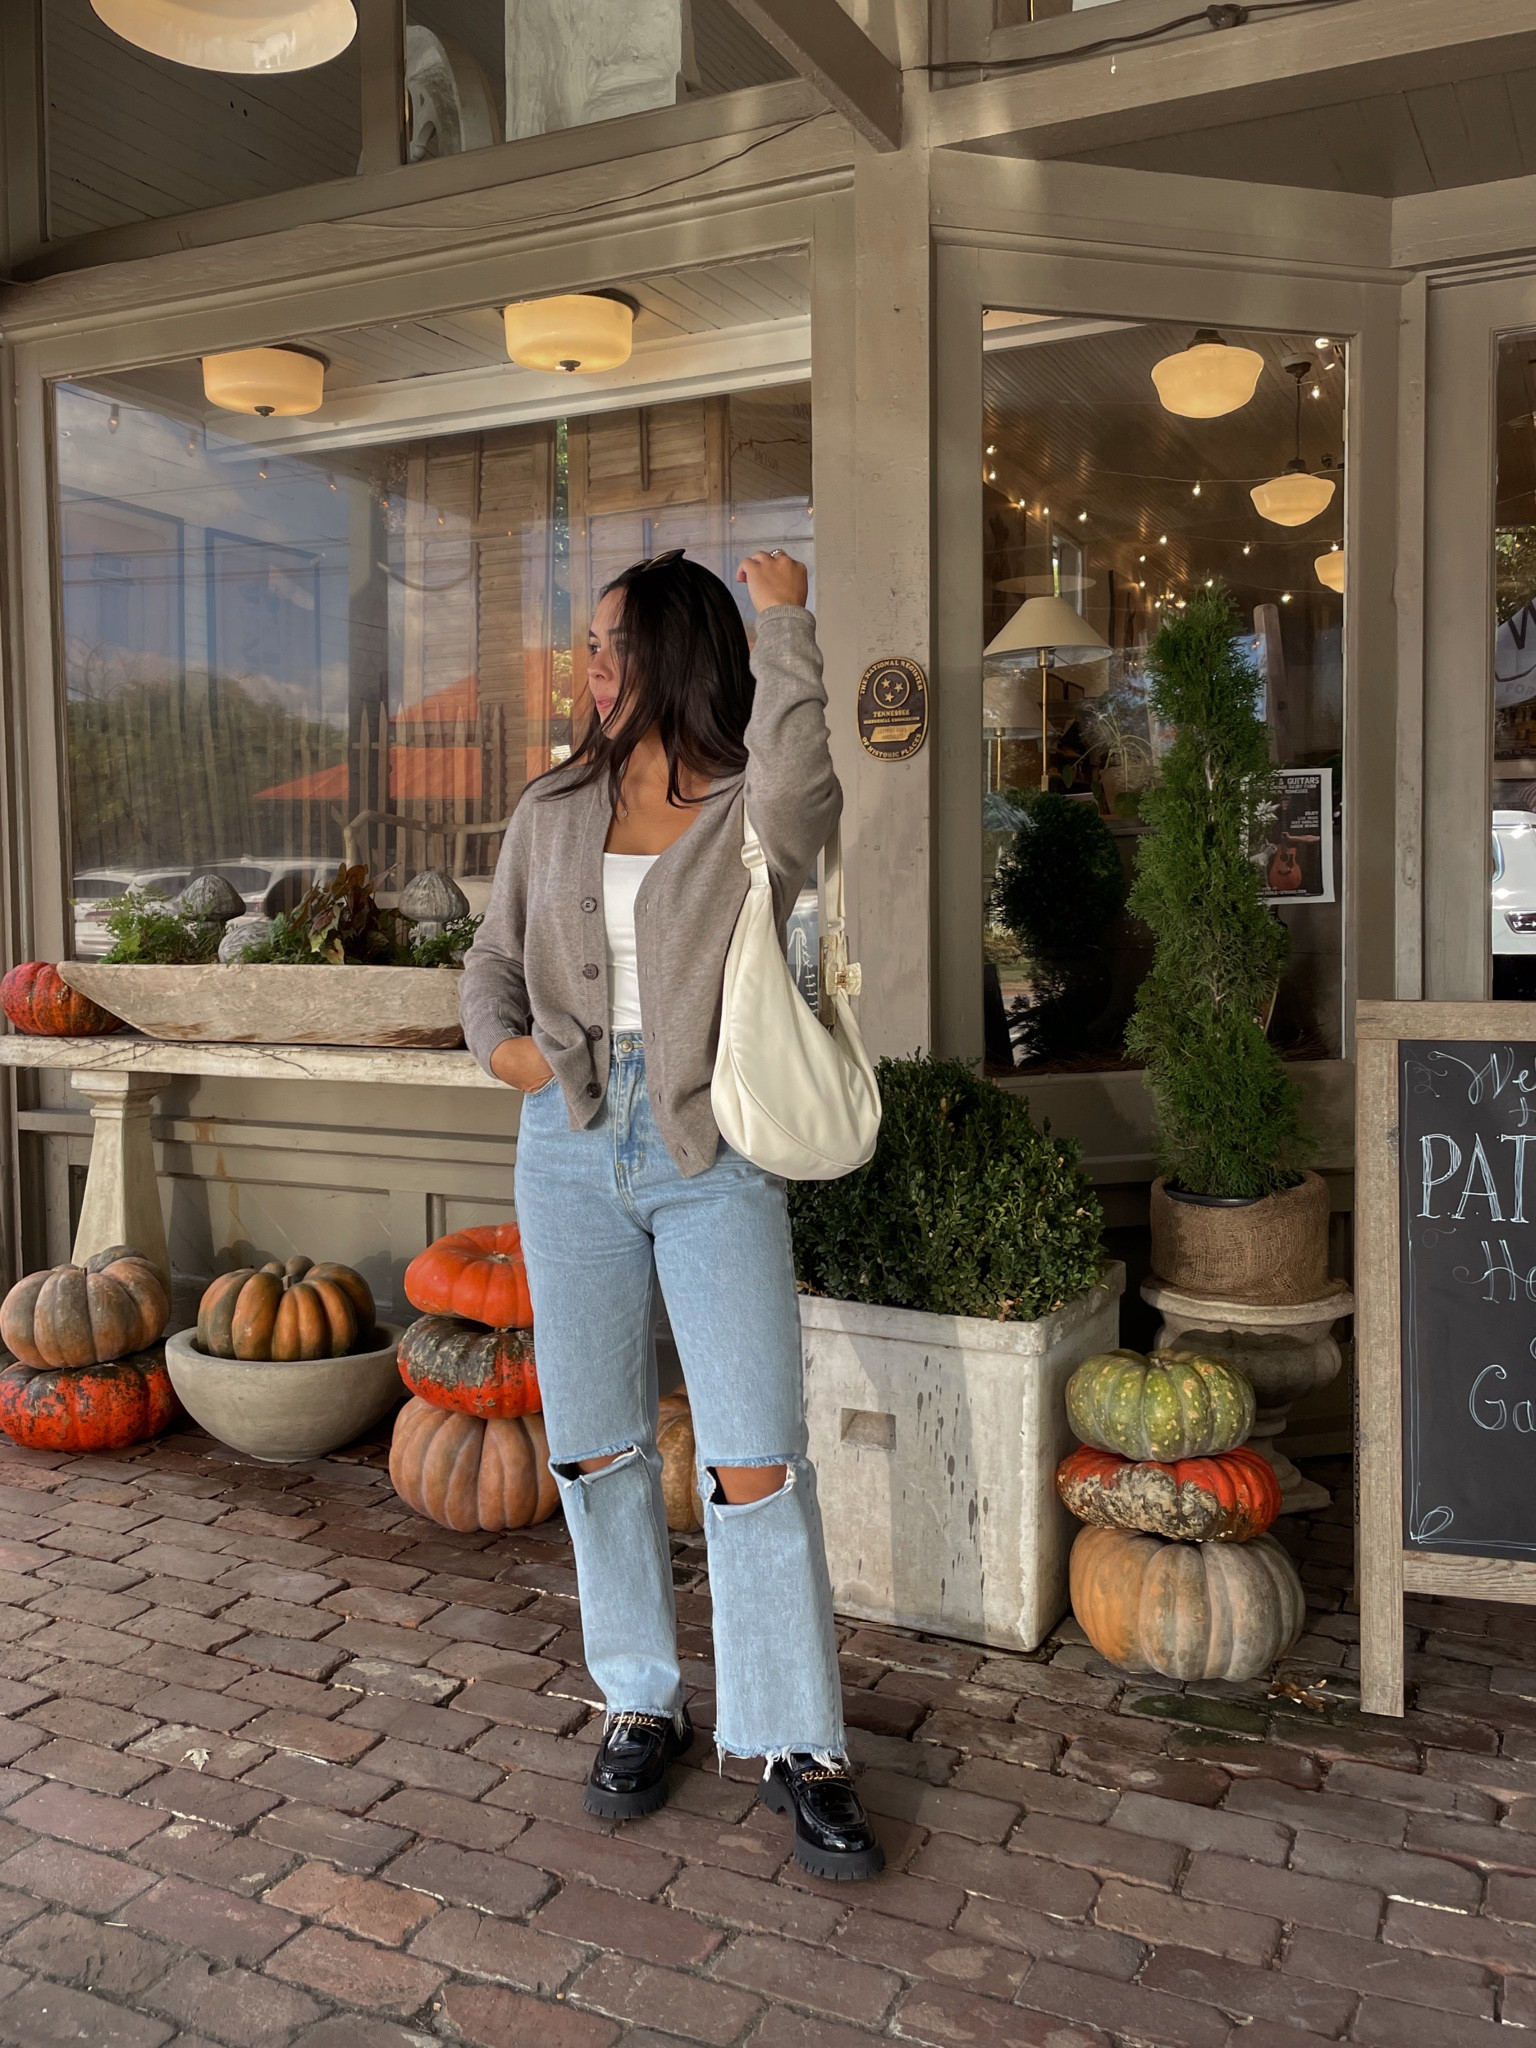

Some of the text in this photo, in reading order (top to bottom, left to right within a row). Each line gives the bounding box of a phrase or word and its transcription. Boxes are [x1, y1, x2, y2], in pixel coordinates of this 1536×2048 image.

[860, 660, 924, 695] THE NATIONAL REGISTER
[873, 709, 911, 718] TENNESSEE
[862, 736, 870, 746] OF
[868, 745, 900, 758] HISTORIC
[901, 733, 922, 756] PLACES
[1287, 776, 1320, 785] GUITARS
[1428, 1046, 1536, 1105] We
[1416, 1132, 1536, 1223] PAT
